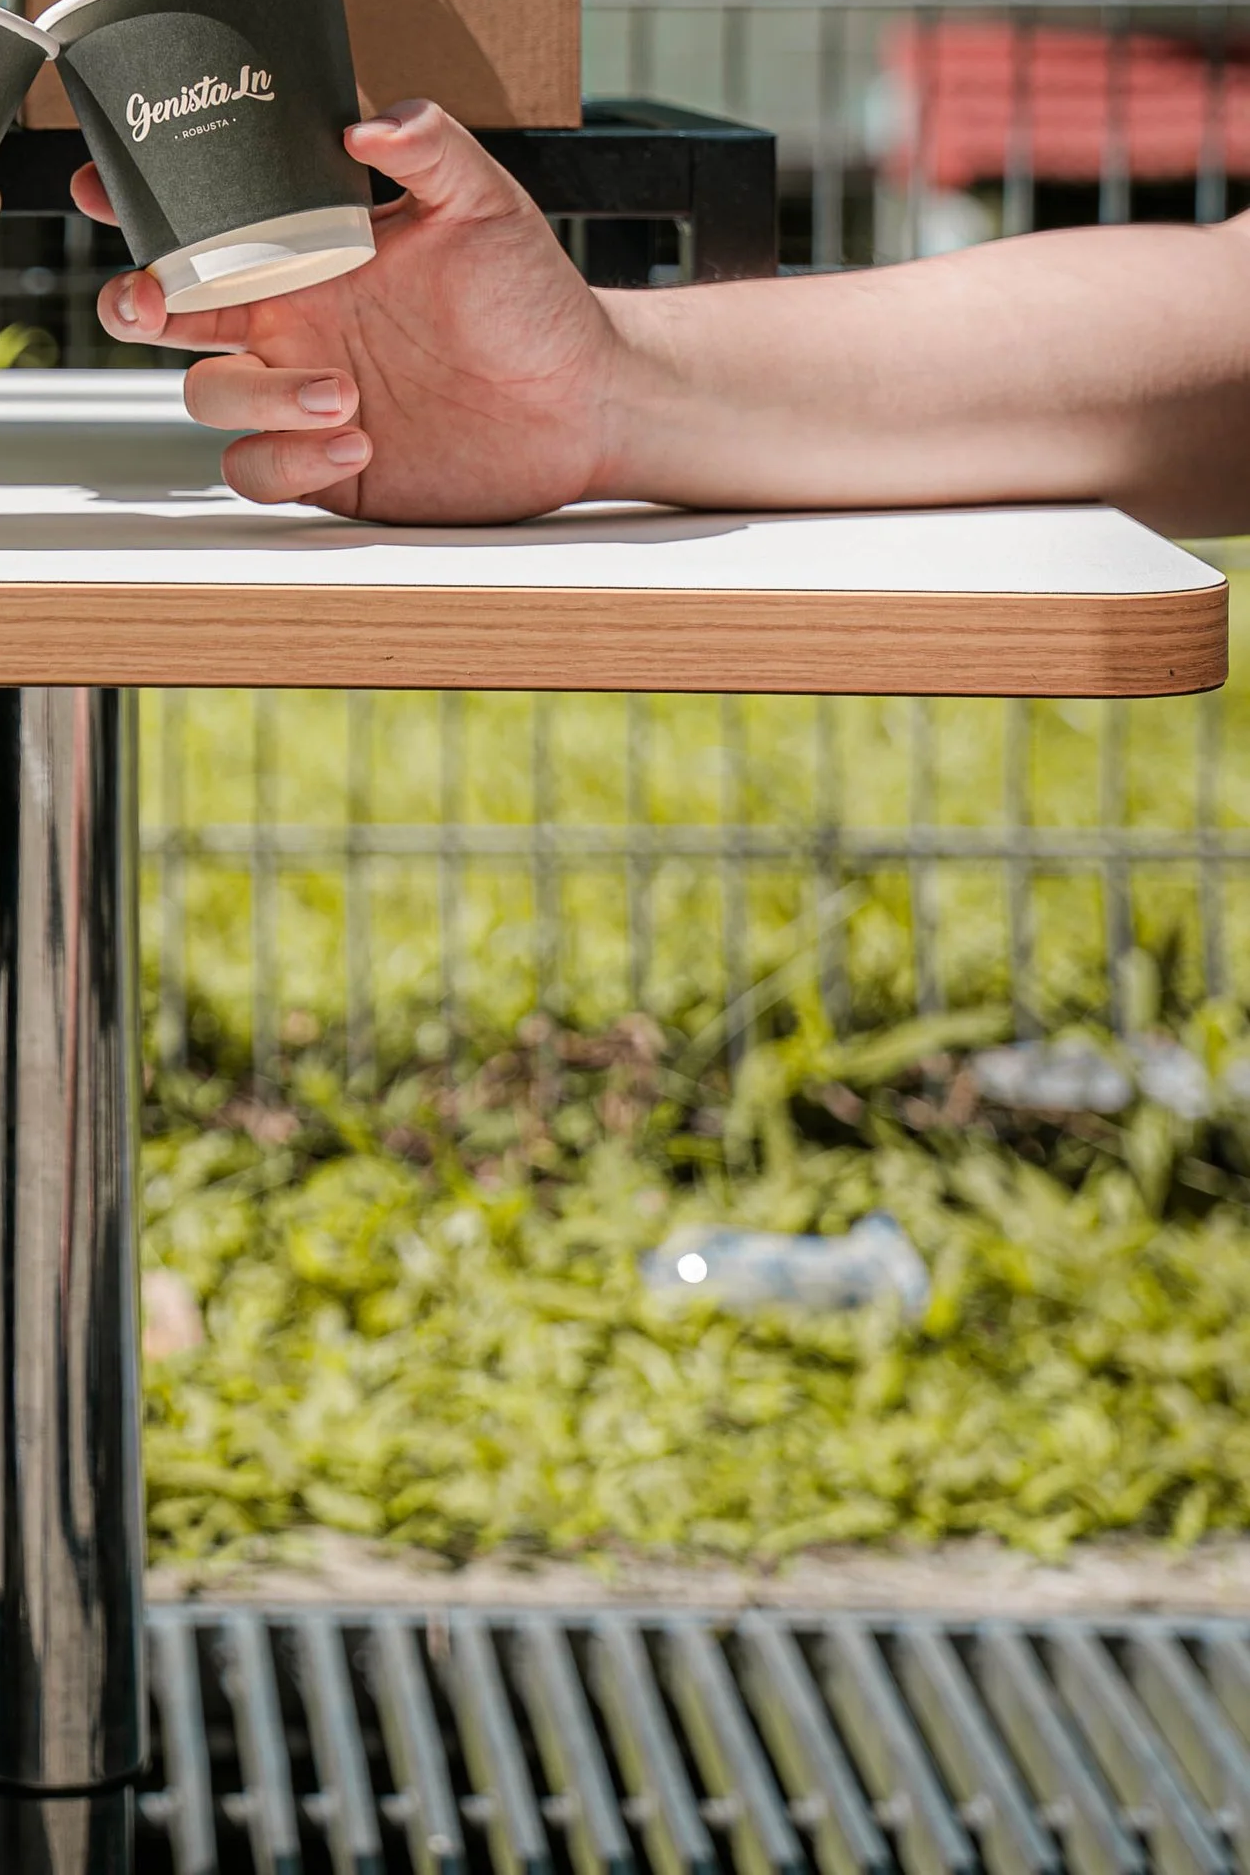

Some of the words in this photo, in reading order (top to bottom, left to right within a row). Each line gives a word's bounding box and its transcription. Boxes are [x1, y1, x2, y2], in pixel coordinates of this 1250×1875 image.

[125, 75, 232, 142] Genista
[230, 65, 275, 102] Ln
[181, 118, 230, 140] ROBUSTA
